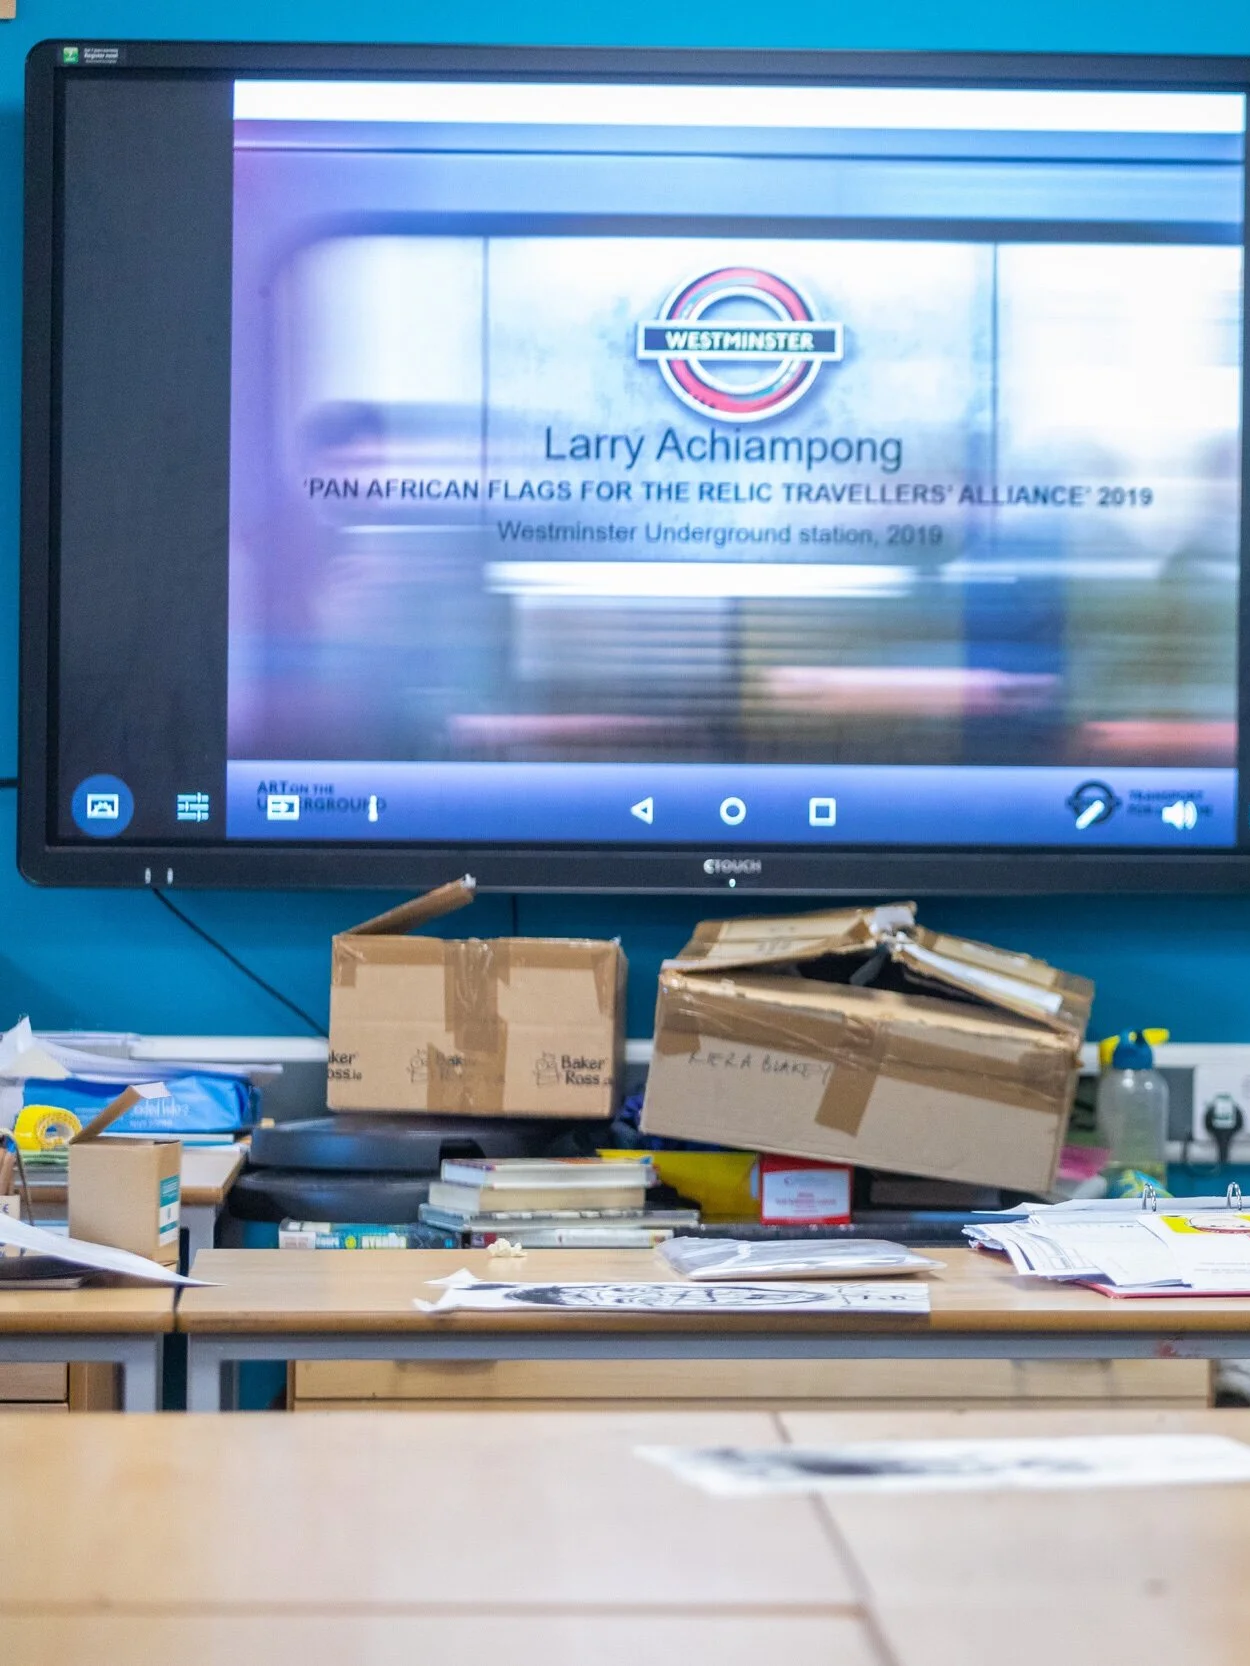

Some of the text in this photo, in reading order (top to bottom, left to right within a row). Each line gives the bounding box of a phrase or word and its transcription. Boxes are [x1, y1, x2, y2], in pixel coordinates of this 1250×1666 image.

[665, 331, 814, 350] WESTMINSTER
[546, 426, 902, 473] Larry Achiampong
[366, 478, 479, 500] AFRICAN
[488, 479, 572, 501] FLAGS
[582, 480, 633, 501] FOR
[641, 481, 690, 501] THE
[699, 481, 772, 502] RELIC
[1098, 486, 1154, 507] 2019
[497, 520, 944, 549] Westminster Underground station, 2019
[257, 780, 288, 794] ART
[312, 784, 335, 795] THE
[561, 1055, 606, 1070] Baker
